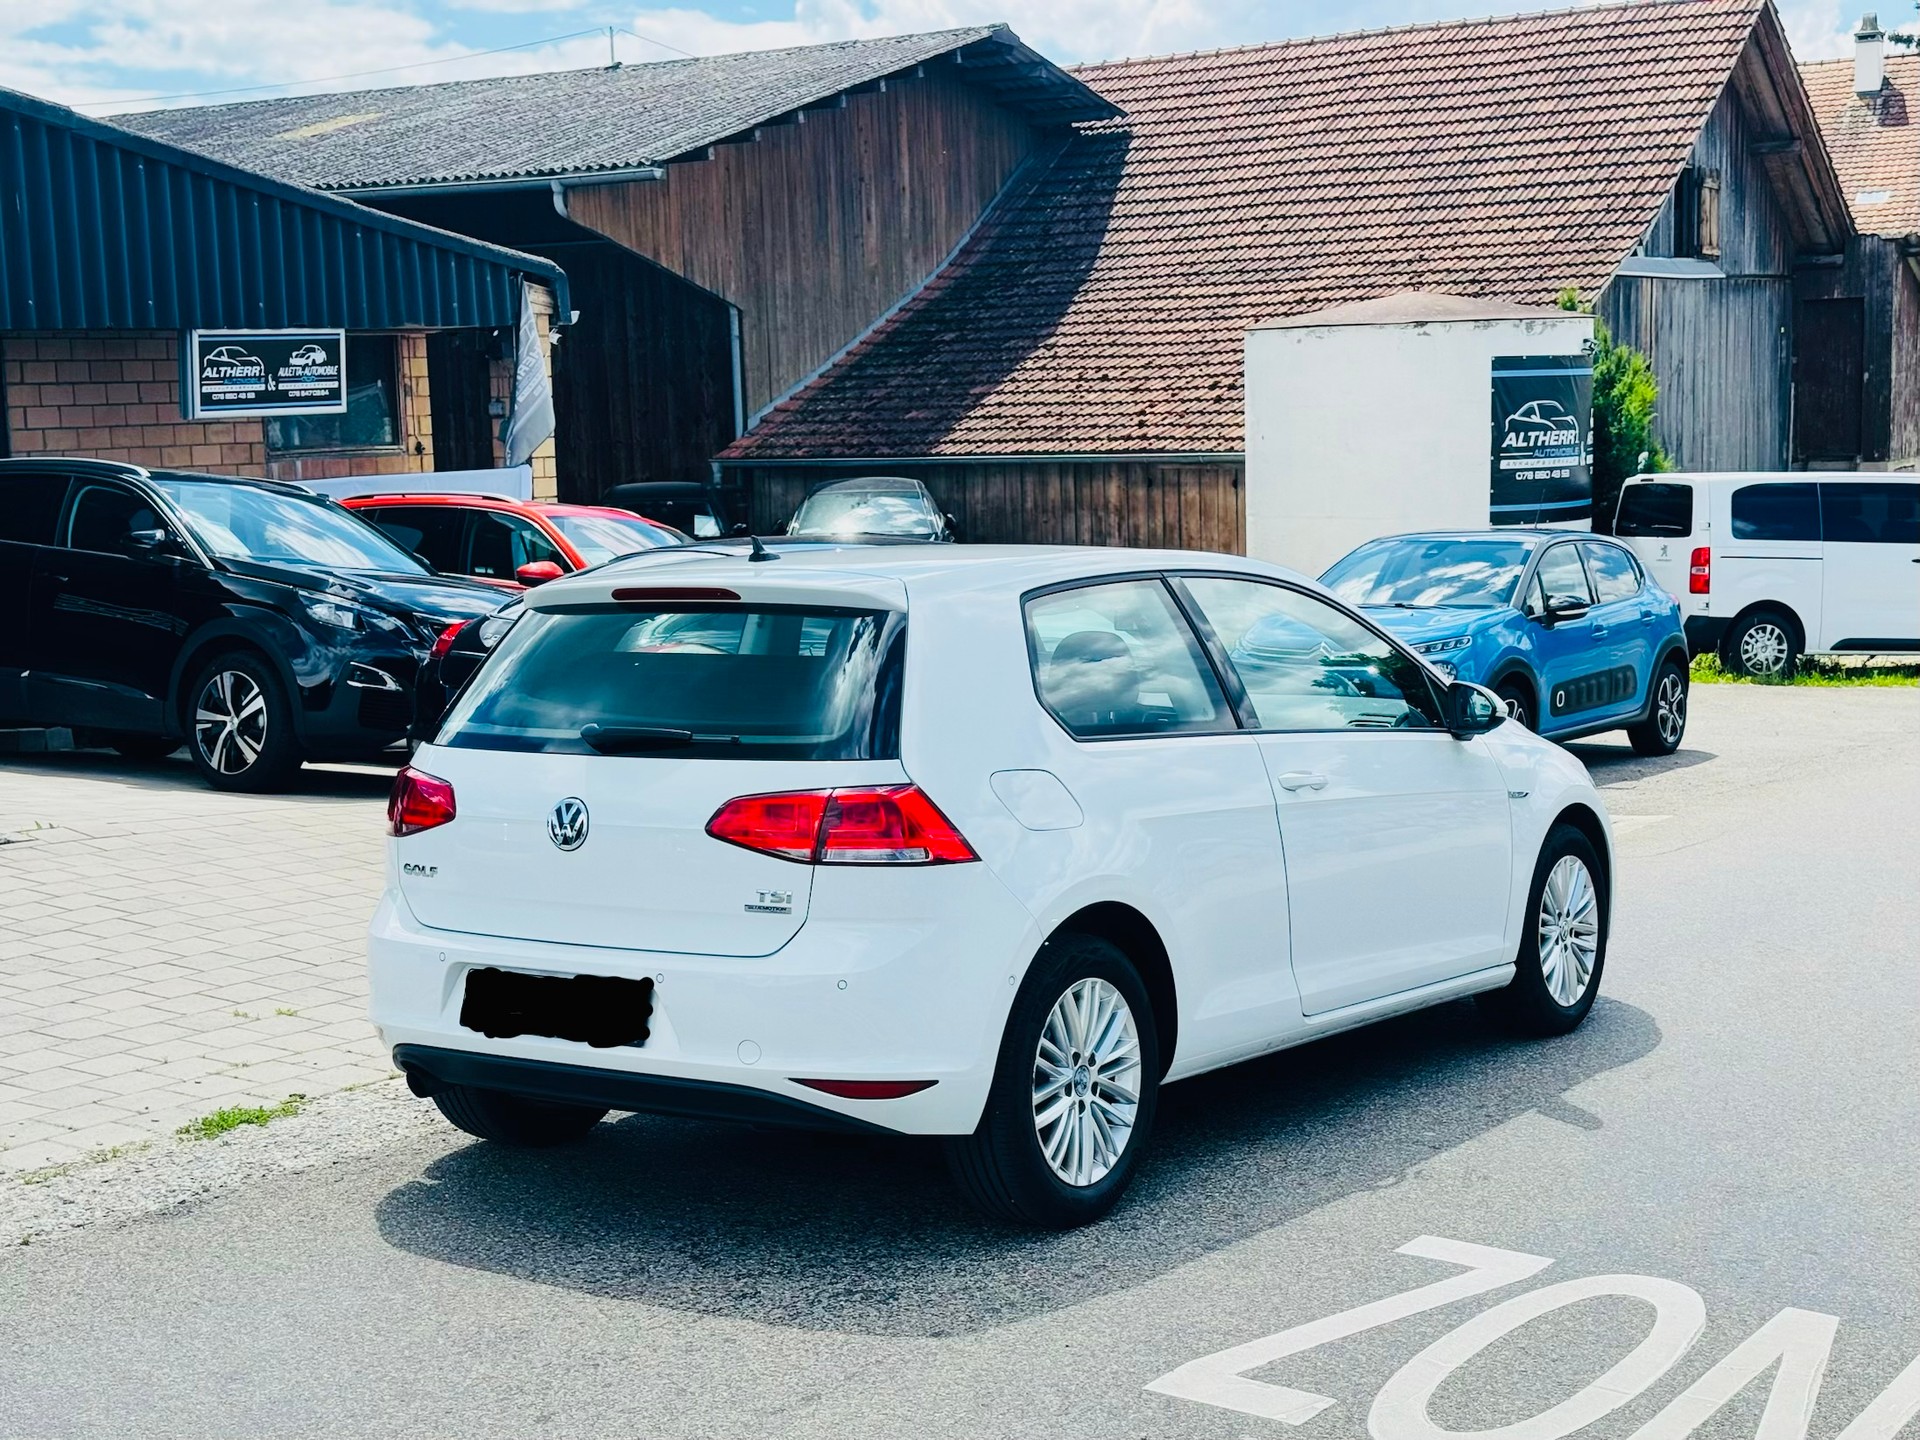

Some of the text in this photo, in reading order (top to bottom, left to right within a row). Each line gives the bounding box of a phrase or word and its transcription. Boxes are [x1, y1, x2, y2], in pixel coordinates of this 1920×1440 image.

[1501, 430, 1576, 448] ALTHERR
[1533, 447, 1579, 457] AUTOMOBILE
[404, 863, 438, 878] GOLF
[756, 889, 792, 904] TSI
